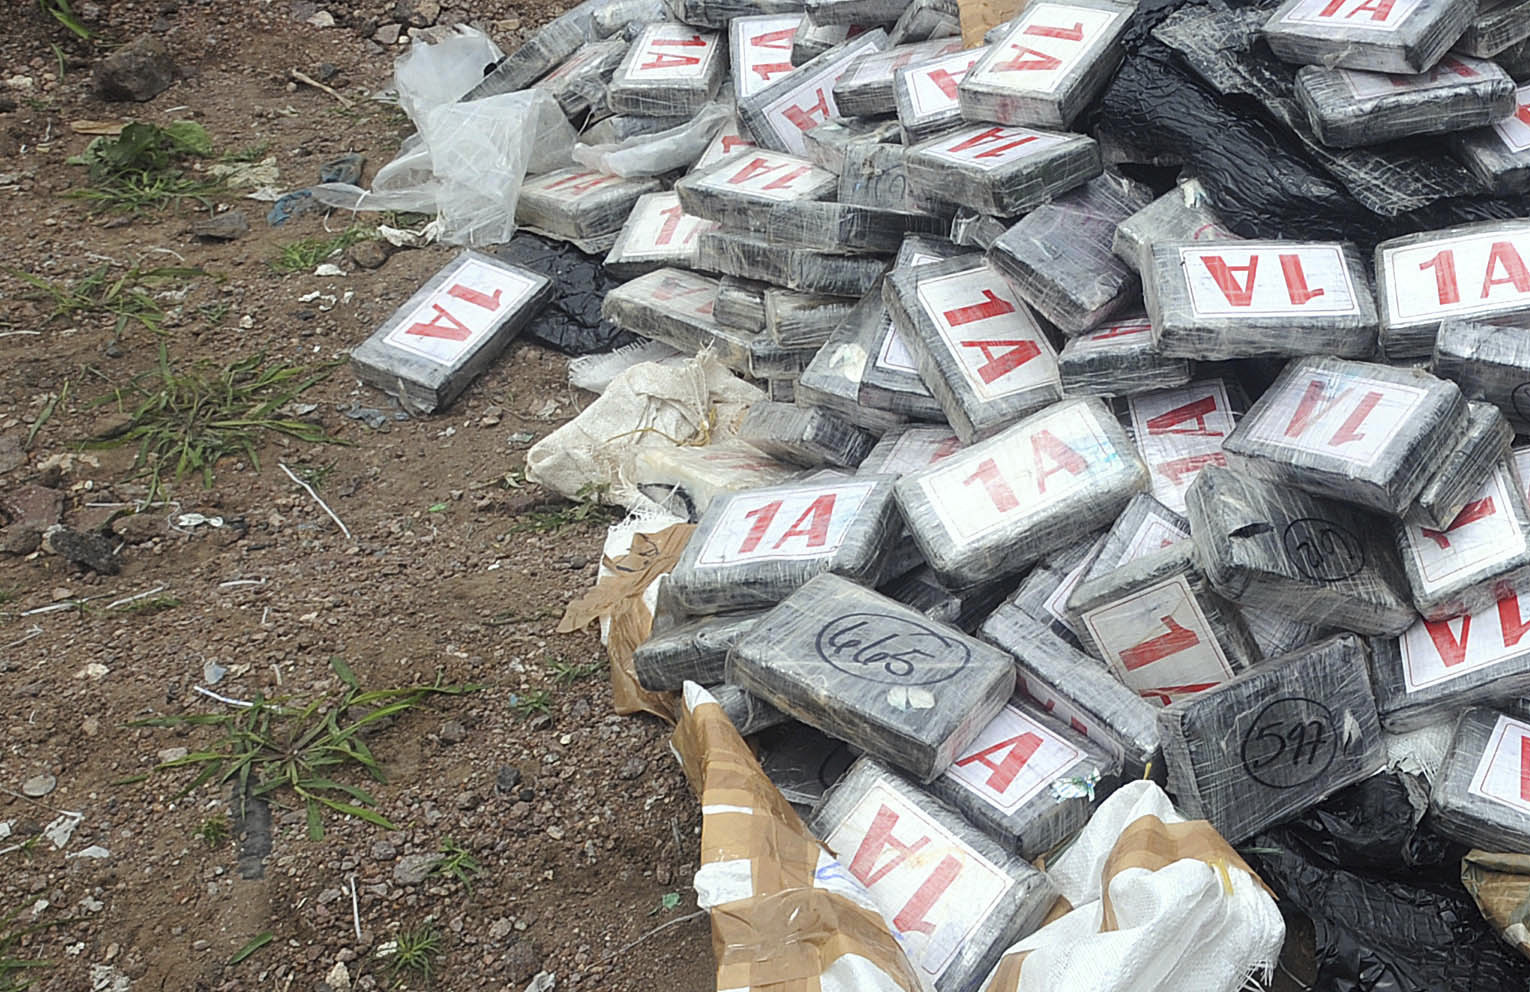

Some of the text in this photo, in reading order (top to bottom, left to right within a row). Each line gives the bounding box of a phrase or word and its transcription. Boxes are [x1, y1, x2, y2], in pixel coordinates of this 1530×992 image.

[641, 35, 707, 70] 1A
[991, 22, 1084, 73] 1A
[947, 127, 1040, 158] 1A
[728, 158, 811, 191] 1A
[1200, 254, 1325, 306] 1A
[405, 284, 503, 342] 1A
[943, 289, 1043, 385] 1A
[1284, 380, 1384, 447] 1A
[963, 429, 1089, 513] 1A
[738, 493, 837, 555] 1A
[828, 621, 936, 677] 665
[849, 803, 964, 936] 1A
